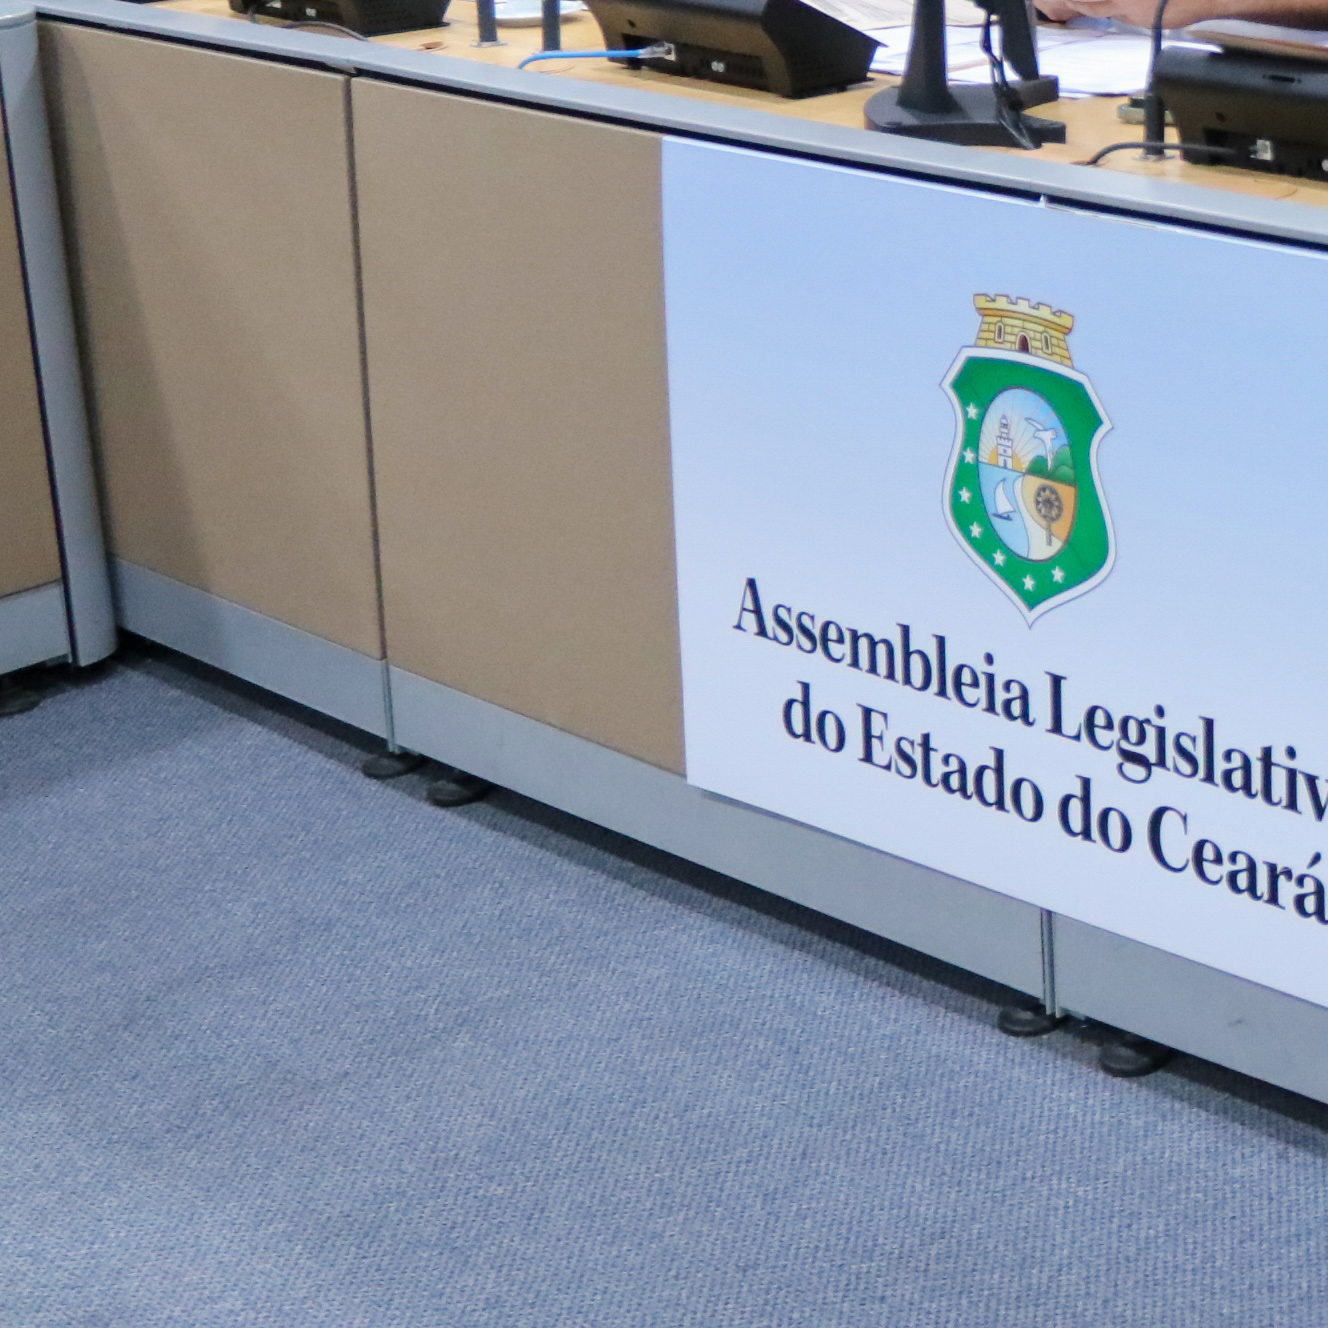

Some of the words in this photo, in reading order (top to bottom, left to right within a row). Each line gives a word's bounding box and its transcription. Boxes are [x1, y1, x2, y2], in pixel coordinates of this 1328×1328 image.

[732, 576, 1036, 728] Assembleia
[782, 681, 847, 754] do
[857, 703, 1045, 824] Estado
[1057, 775, 1134, 854] do
